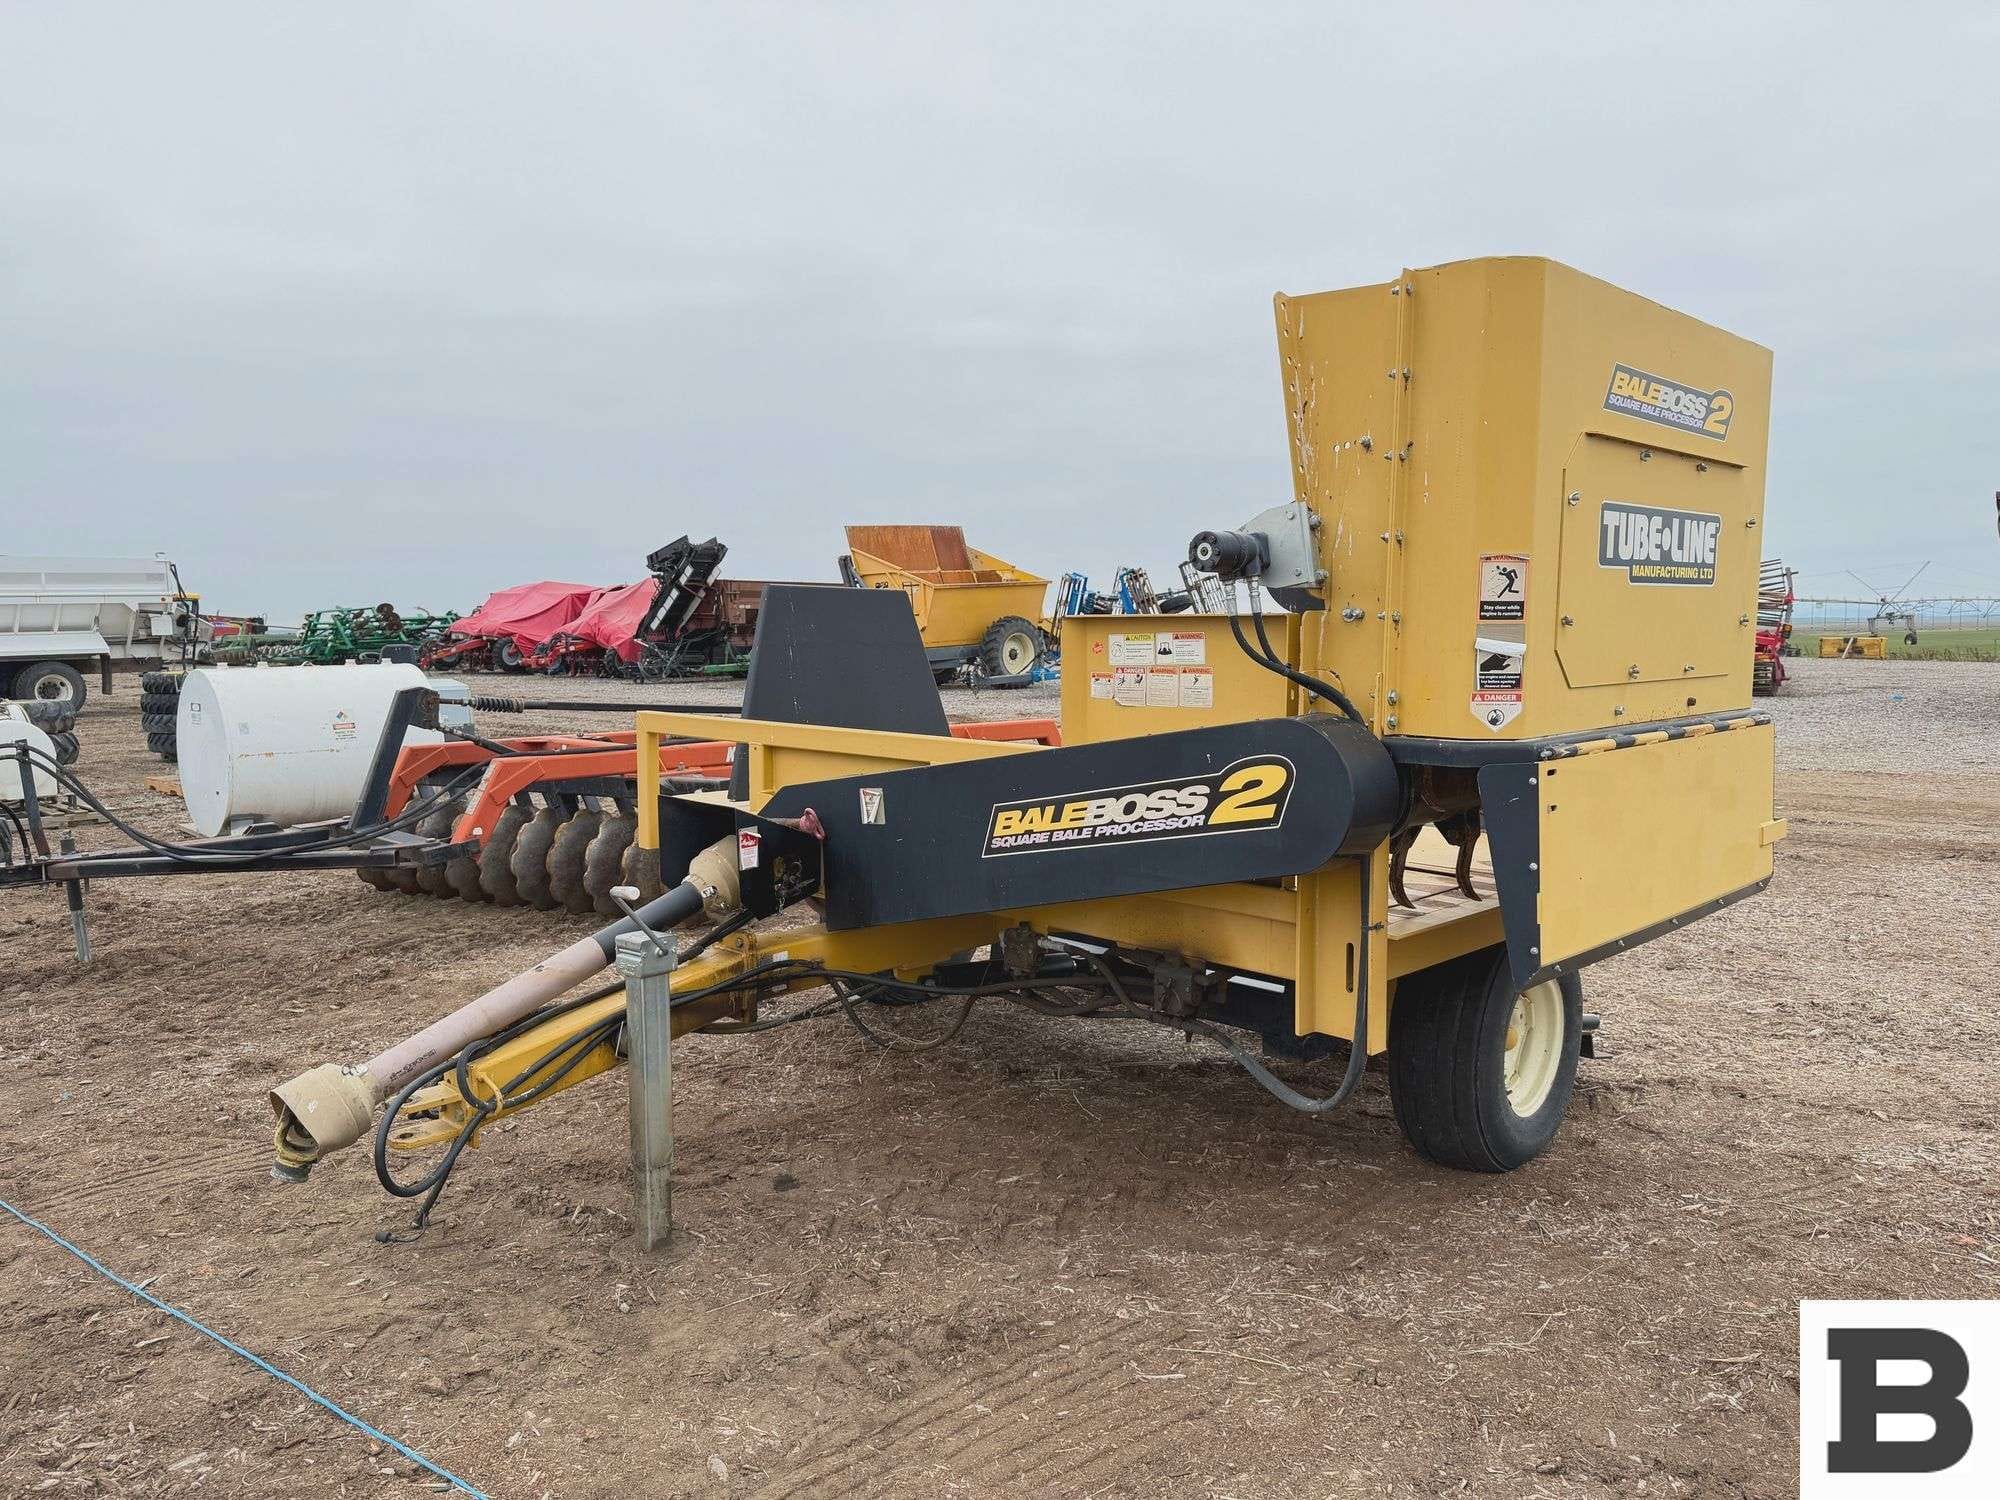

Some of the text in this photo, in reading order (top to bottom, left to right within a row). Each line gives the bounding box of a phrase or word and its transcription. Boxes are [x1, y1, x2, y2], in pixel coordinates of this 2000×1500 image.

[1608, 394, 1704, 429] SQUARE BALE PROCESSOR
[1704, 395, 1732, 434] 2
[1632, 565, 1714, 579] MANUFACTURING LTD
[1207, 764, 1288, 825] 2
[990, 814, 1206, 849] SQUARE BALE PROCESSOR
